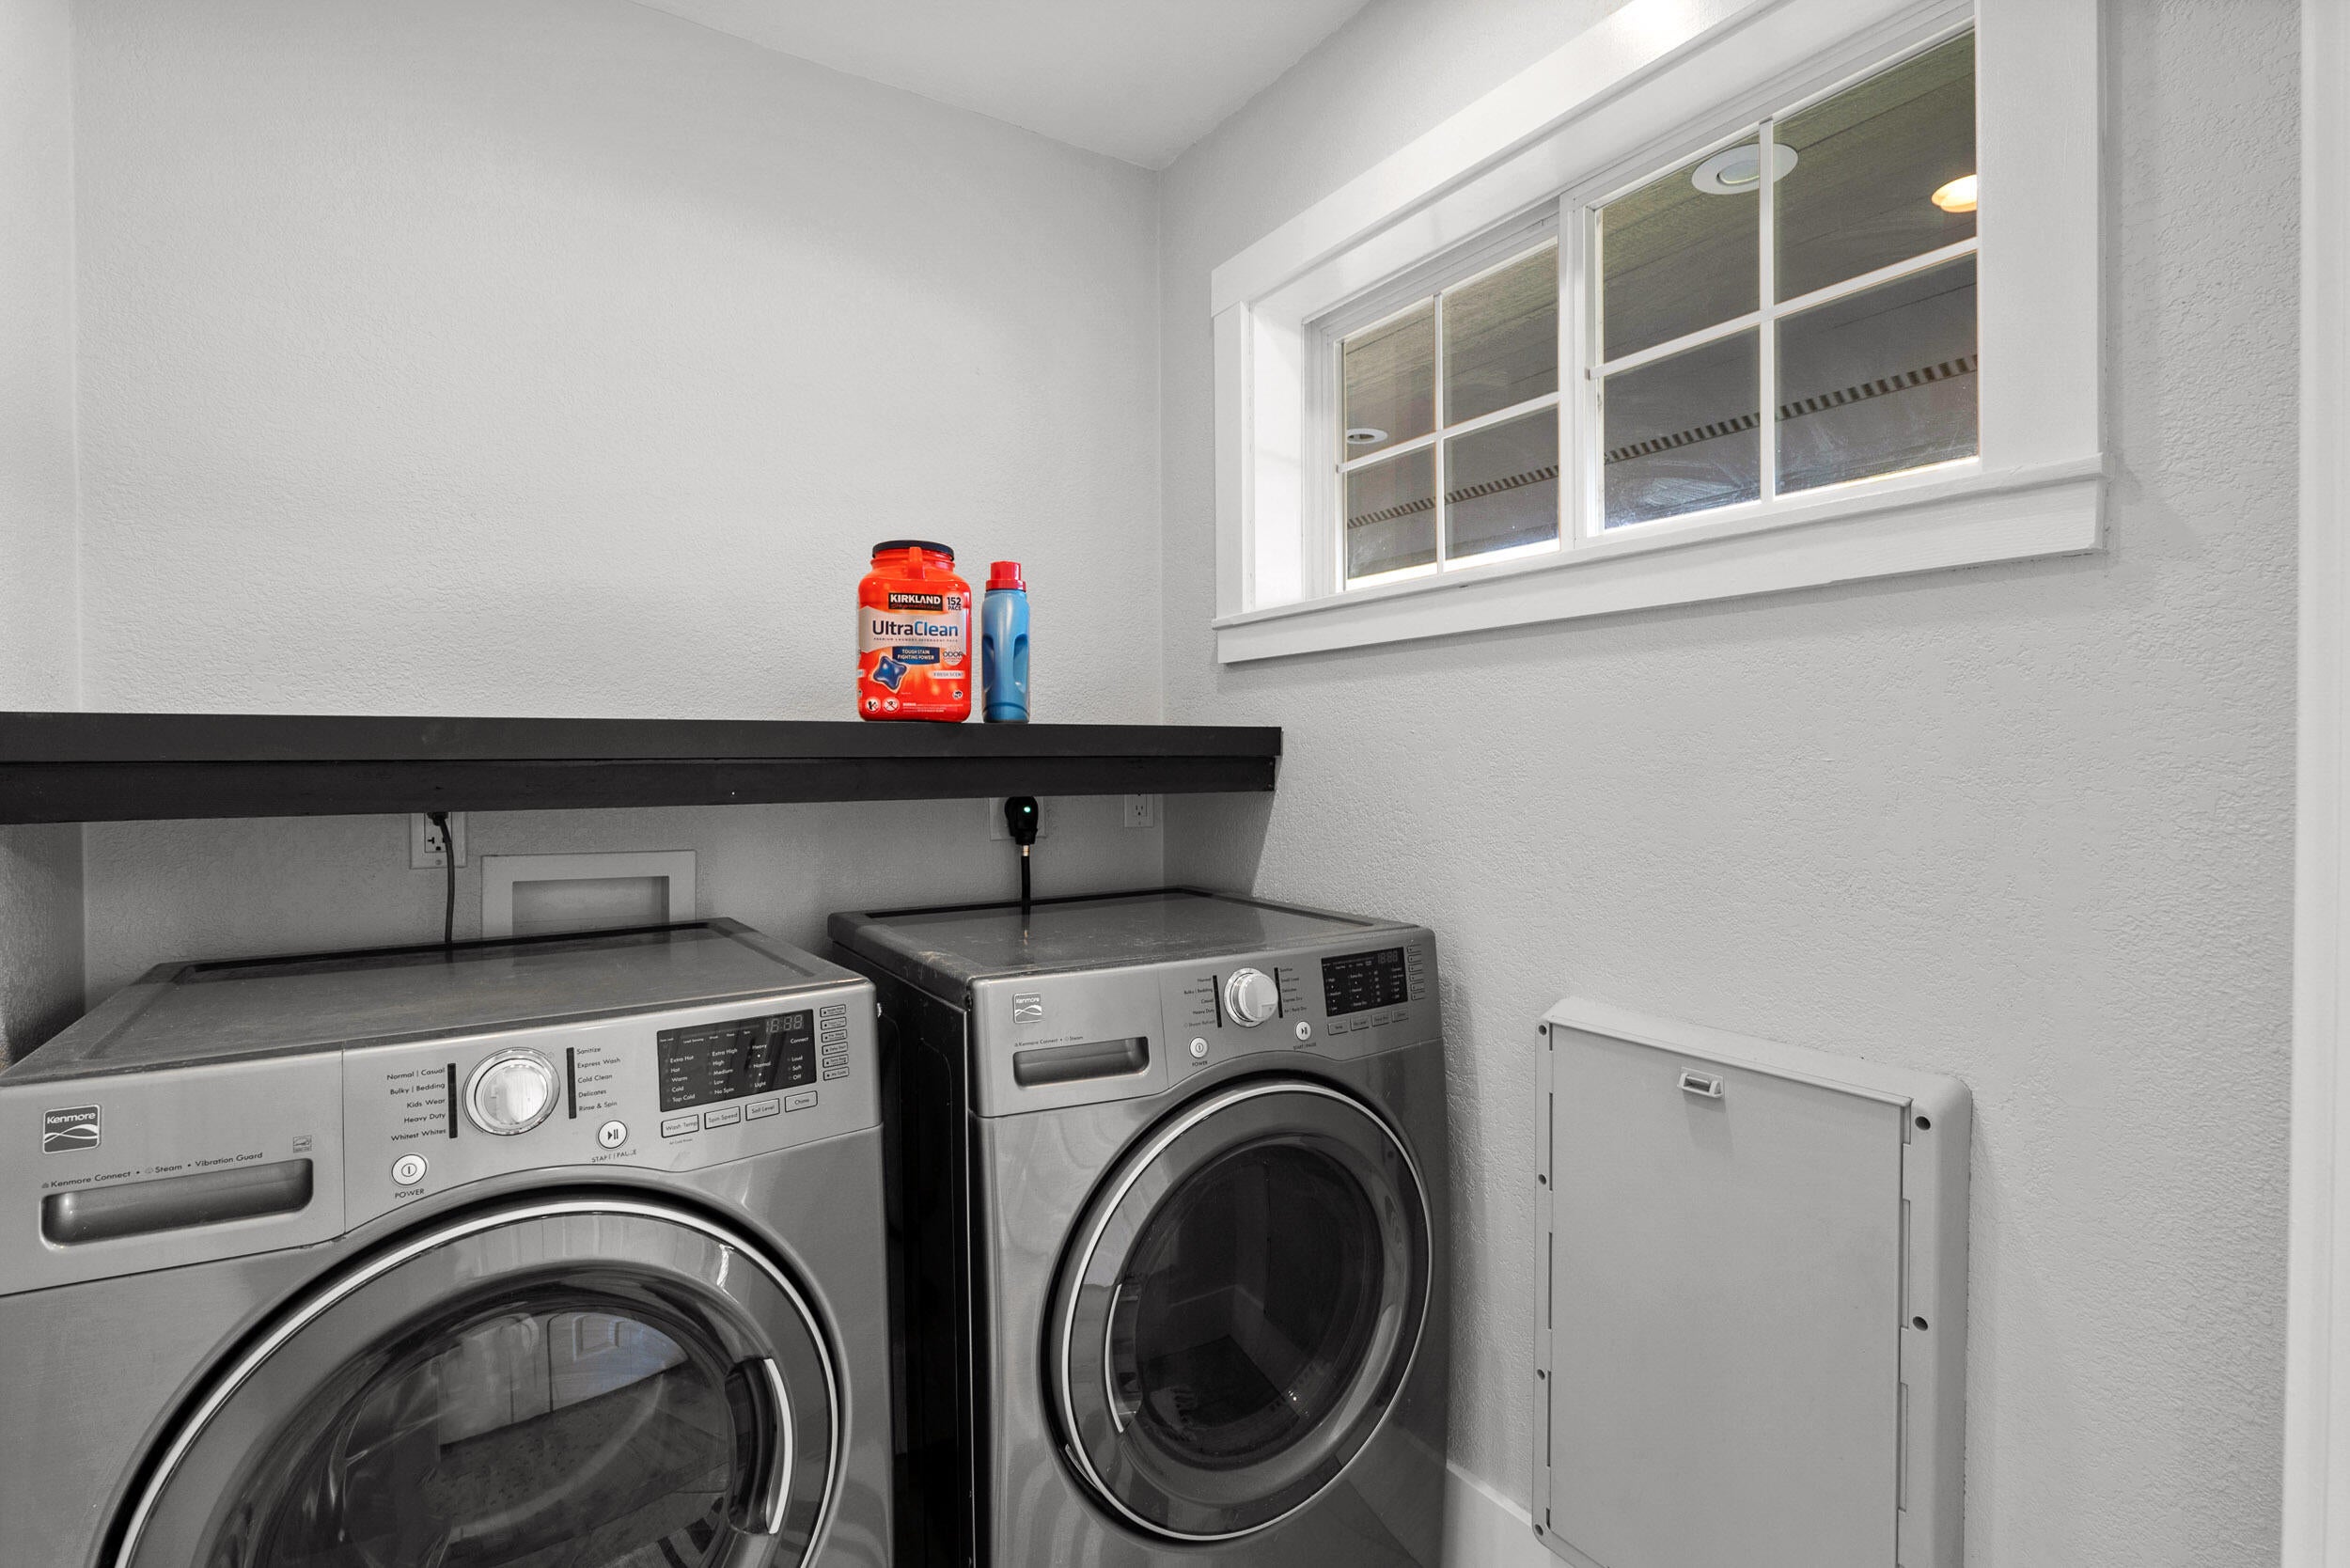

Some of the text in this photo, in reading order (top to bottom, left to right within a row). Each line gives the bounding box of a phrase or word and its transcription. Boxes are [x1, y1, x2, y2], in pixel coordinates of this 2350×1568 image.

[890, 594, 942, 605] KIRKLAND
[948, 596, 962, 606] 152
[872, 620, 958, 636] UltraClean
[386, 1067, 445, 1080] Normal Casual
[578, 1075, 593, 1084] Cold
[416, 1083, 446, 1091] Bedding
[578, 1090, 607, 1098] Delicates
[407, 1101, 423, 1109] Kids
[47, 1112, 96, 1124] Kenmore
[404, 1112, 446, 1124] Heavy Duty
[391, 1128, 446, 1141] Whitest Whites
[51, 1152, 263, 1188] Kenmore Connect Steam Vibration Guard
[395, 1188, 425, 1199] POWER
